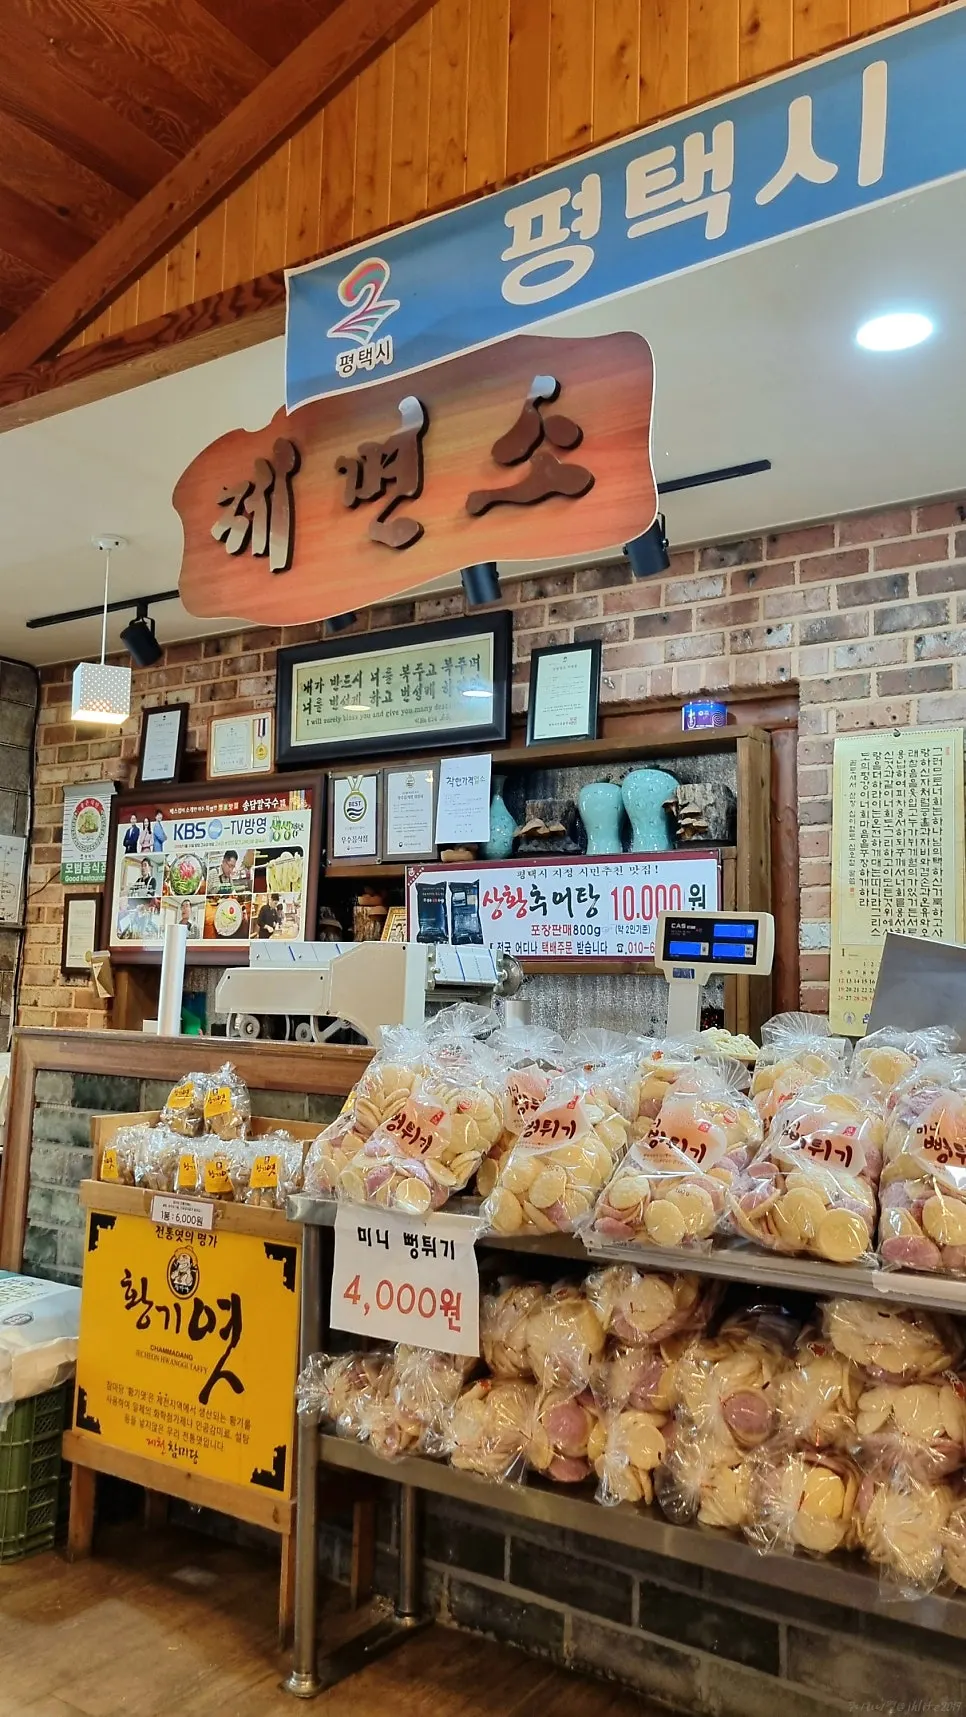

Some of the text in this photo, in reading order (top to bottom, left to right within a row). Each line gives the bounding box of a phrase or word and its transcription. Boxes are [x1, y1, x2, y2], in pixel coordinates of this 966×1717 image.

[501, 60, 888, 306] 평택시
[339, 338, 392, 375] 평택시
[211, 374, 596, 573] 제면소
[303, 654, 480, 695] 내가 반드시 너를 복주고 복주며
[302, 697, 323, 715] 너를
[369, 689, 393, 707] 하고
[311, 717, 322, 725] will
[385, 709, 399, 718] give
[400, 708, 413, 717] you
[445, 775, 486, 788] 착한가격업소
[348, 800, 361, 808] BEST
[173, 822, 206, 841] KBS
[64, 875, 80, 883] Good
[516, 864, 659, 880] 평택시 지정 시민추천 맛집!
[515, 941, 538, 954] 어디나
[541, 941, 573, 954] 택배주문
[576, 940, 608, 954] 받습니다
[161, 1210, 170, 1221] 1봉
[175, 1213, 203, 1227] 6,000원
[155, 1225, 218, 1248] 전통엿의 명가
[357, 1226, 455, 1260] 미니 뻥튀기
[343, 1274, 462, 1333] 4,000원
[120, 1268, 245, 1405] 황기엿
[150, 1344, 194, 1361] CHAMMADANG
[146, 1438, 166, 1455] 제천
